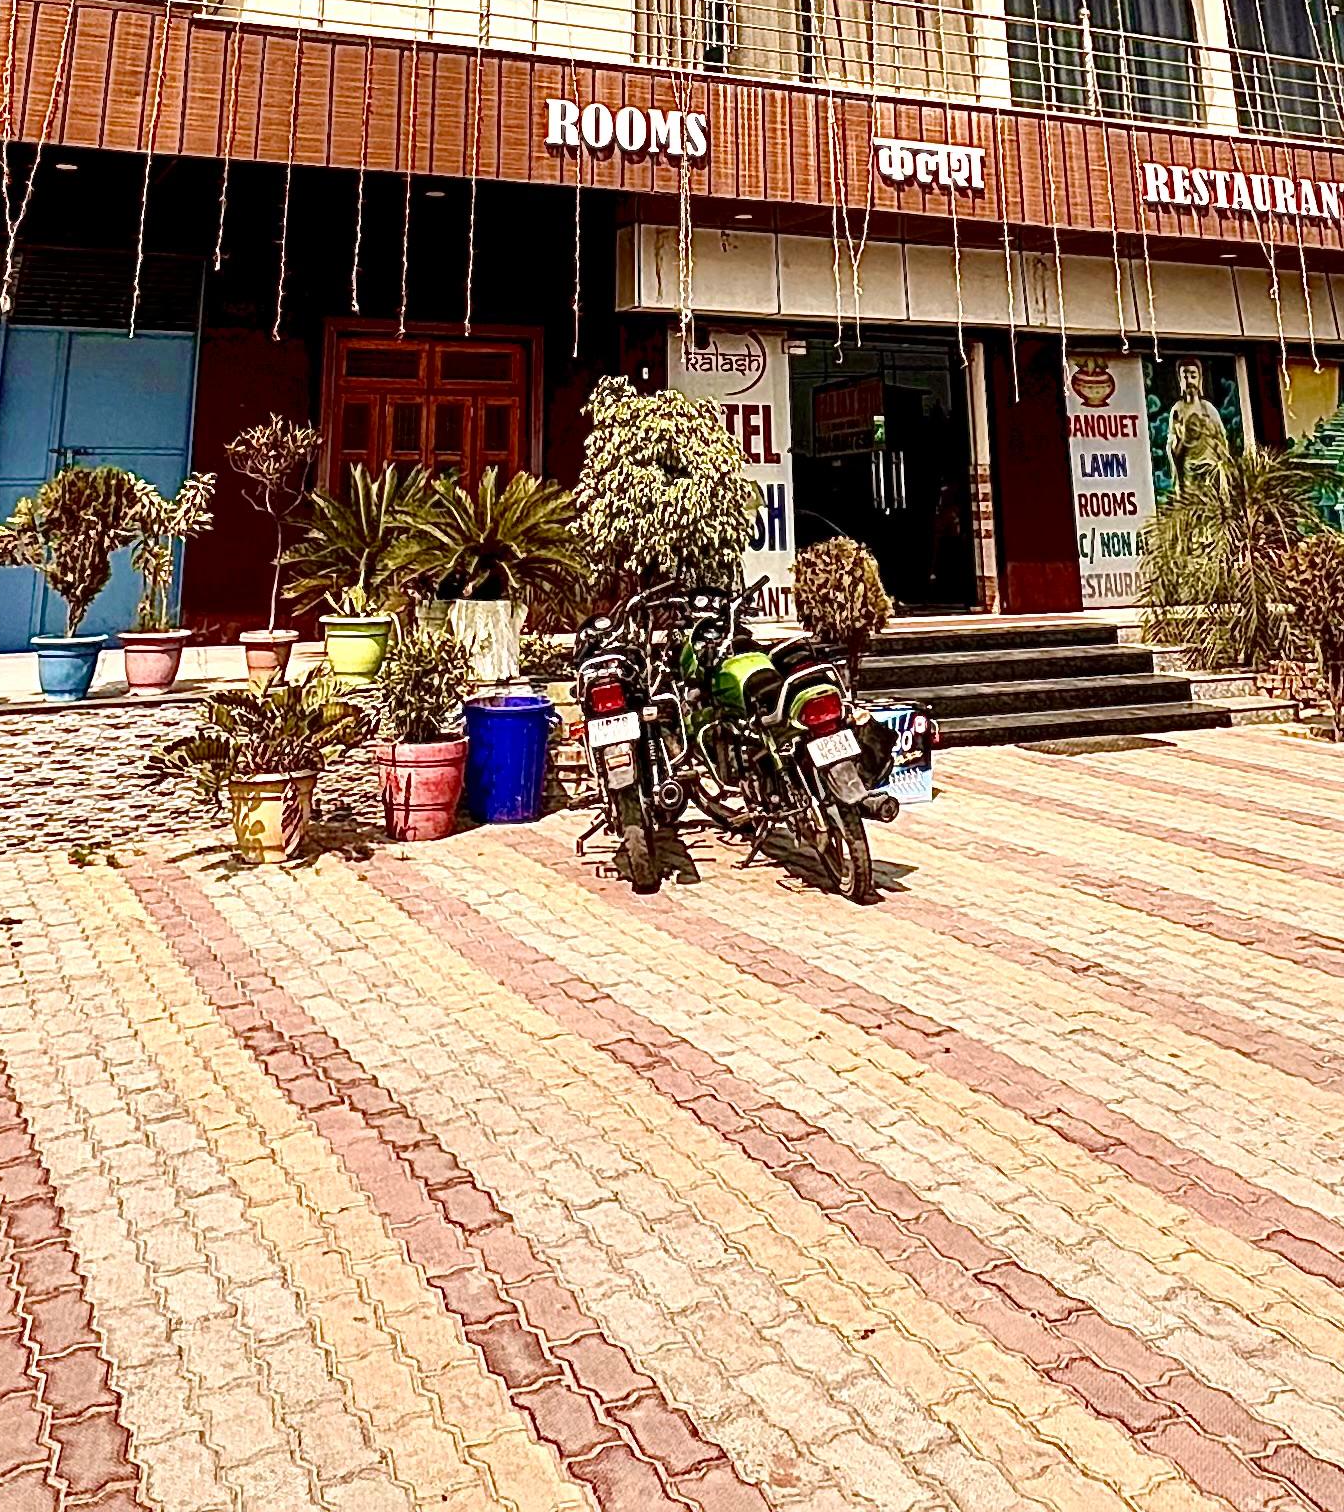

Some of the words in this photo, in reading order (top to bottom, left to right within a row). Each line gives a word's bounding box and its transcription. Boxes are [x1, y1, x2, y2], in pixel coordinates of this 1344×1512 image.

[544, 98, 707, 157] ROOMS
[872, 137, 986, 189] कलश
[720, 404, 782, 464] TEL
[1079, 453, 1128, 478] LAWN
[1077, 492, 1138, 517] ROOMS
[1078, 528, 1096, 564] C/
[1100, 531, 1132, 557] NON
[1082, 571, 1144, 599] STAURA
